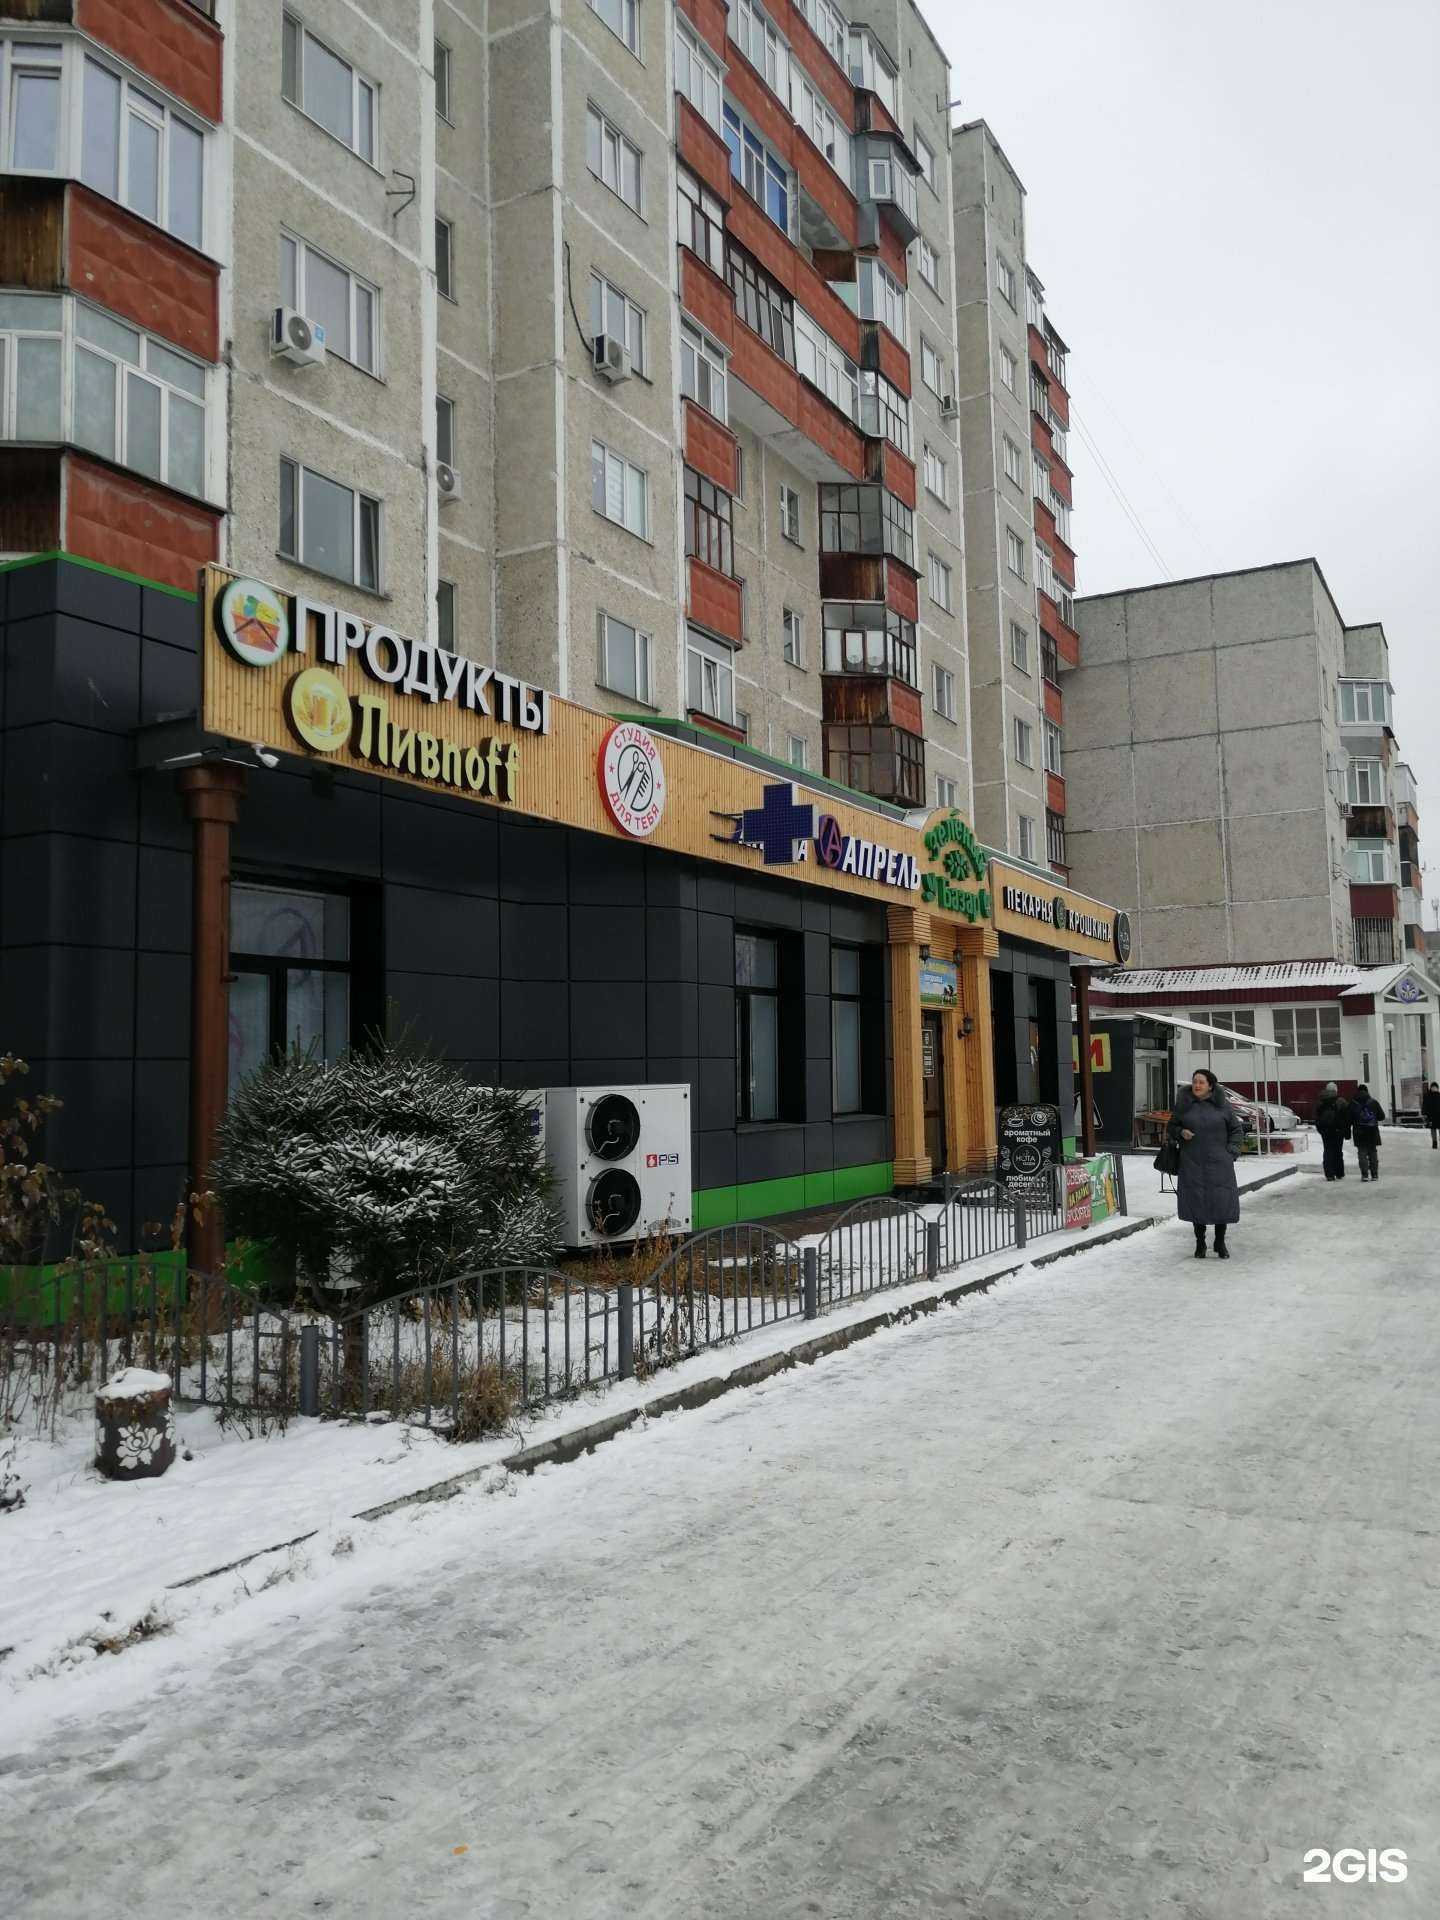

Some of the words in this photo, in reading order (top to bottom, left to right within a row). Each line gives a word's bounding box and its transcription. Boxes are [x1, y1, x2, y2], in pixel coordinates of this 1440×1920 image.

[296, 597, 551, 735] ПРОДУКТЫ
[614, 727, 656, 761] СТУДИЯ
[610, 792, 632, 826] ДЛЯ
[635, 803, 660, 830] ТЕБЯ
[842, 836, 922, 890] АПРЕЛЬ
[1006, 886, 1054, 924] ПЕКАРНЯ
[1069, 909, 1111, 942] КРОШКИНА
[1004, 1129, 1051, 1139] ароматный
[1016, 1135, 1038, 1144] кофе
